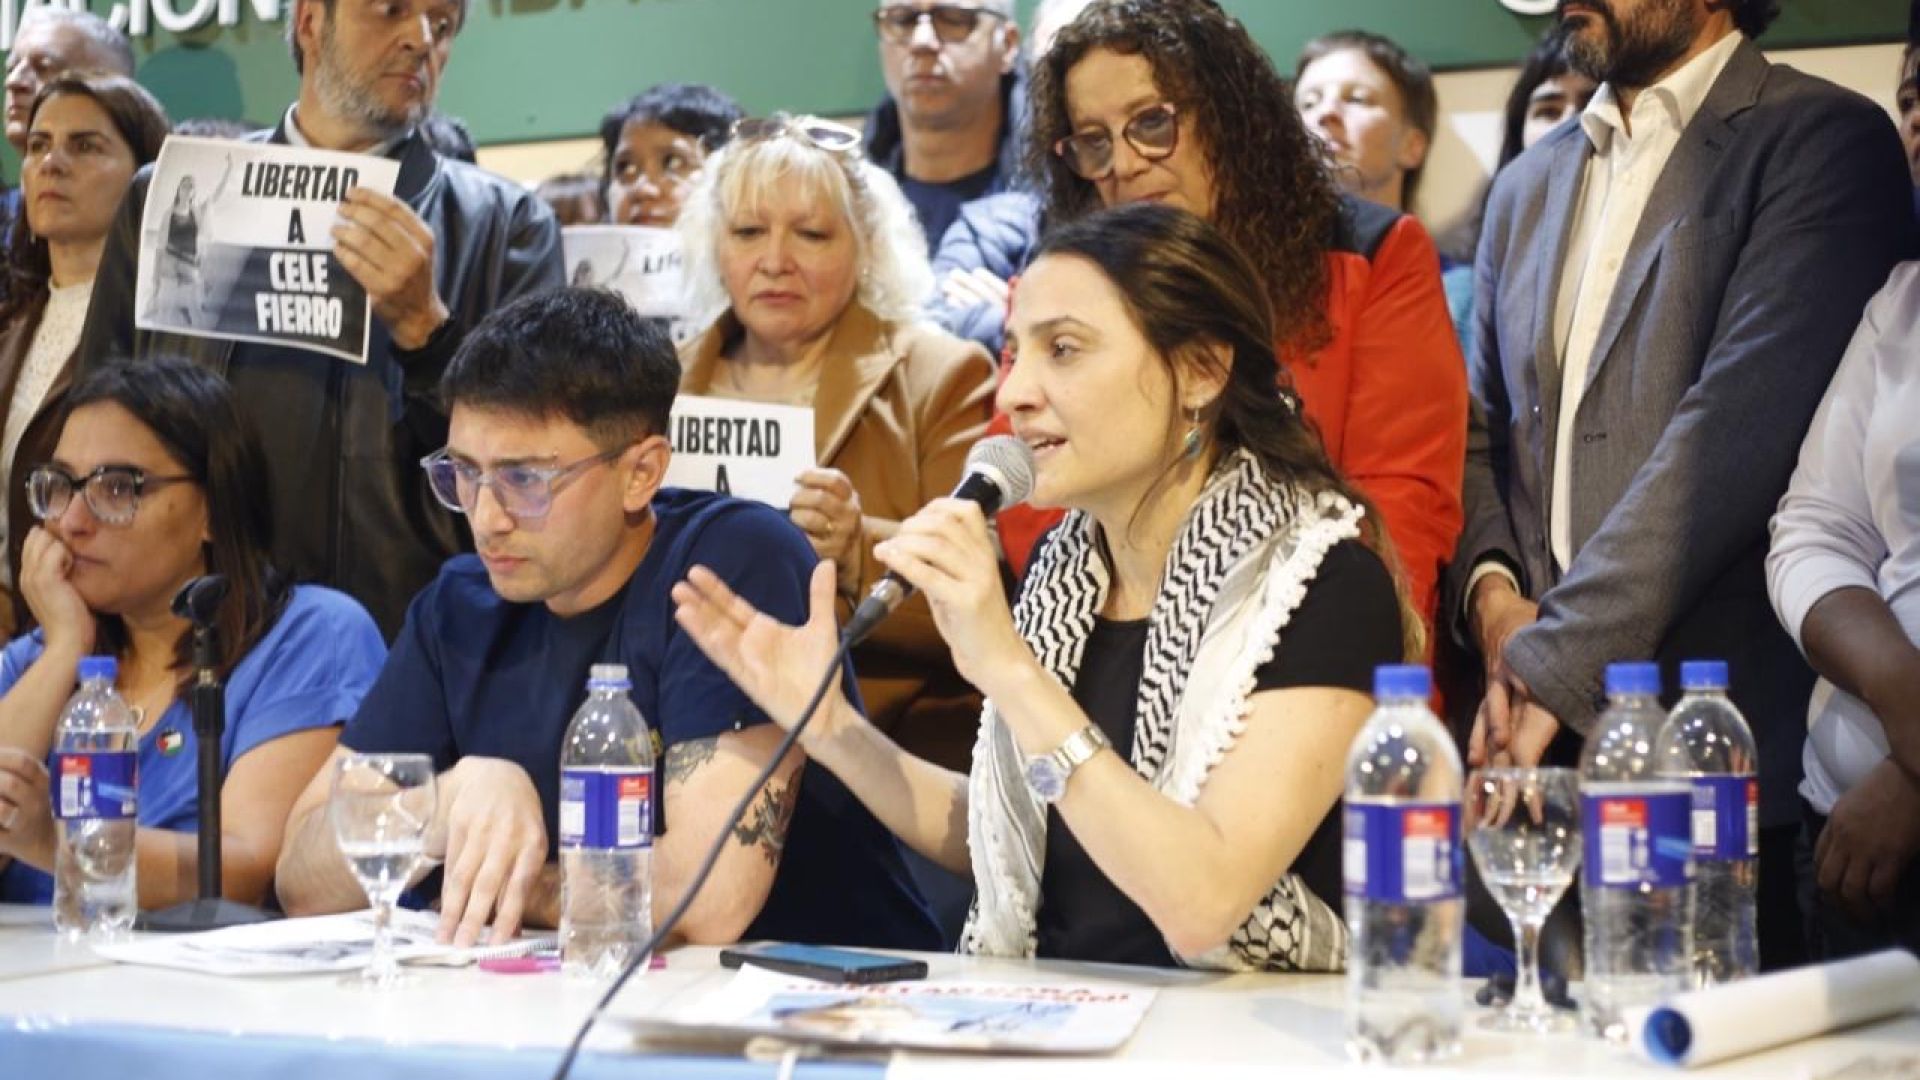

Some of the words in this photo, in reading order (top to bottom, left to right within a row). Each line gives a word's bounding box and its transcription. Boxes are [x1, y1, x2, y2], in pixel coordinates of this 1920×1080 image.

[242, 161, 359, 202] LIBERTAD
[287, 207, 306, 244] A
[269, 251, 329, 293] CELE
[255, 292, 343, 339] FIERRO
[716, 464, 732, 497] A
